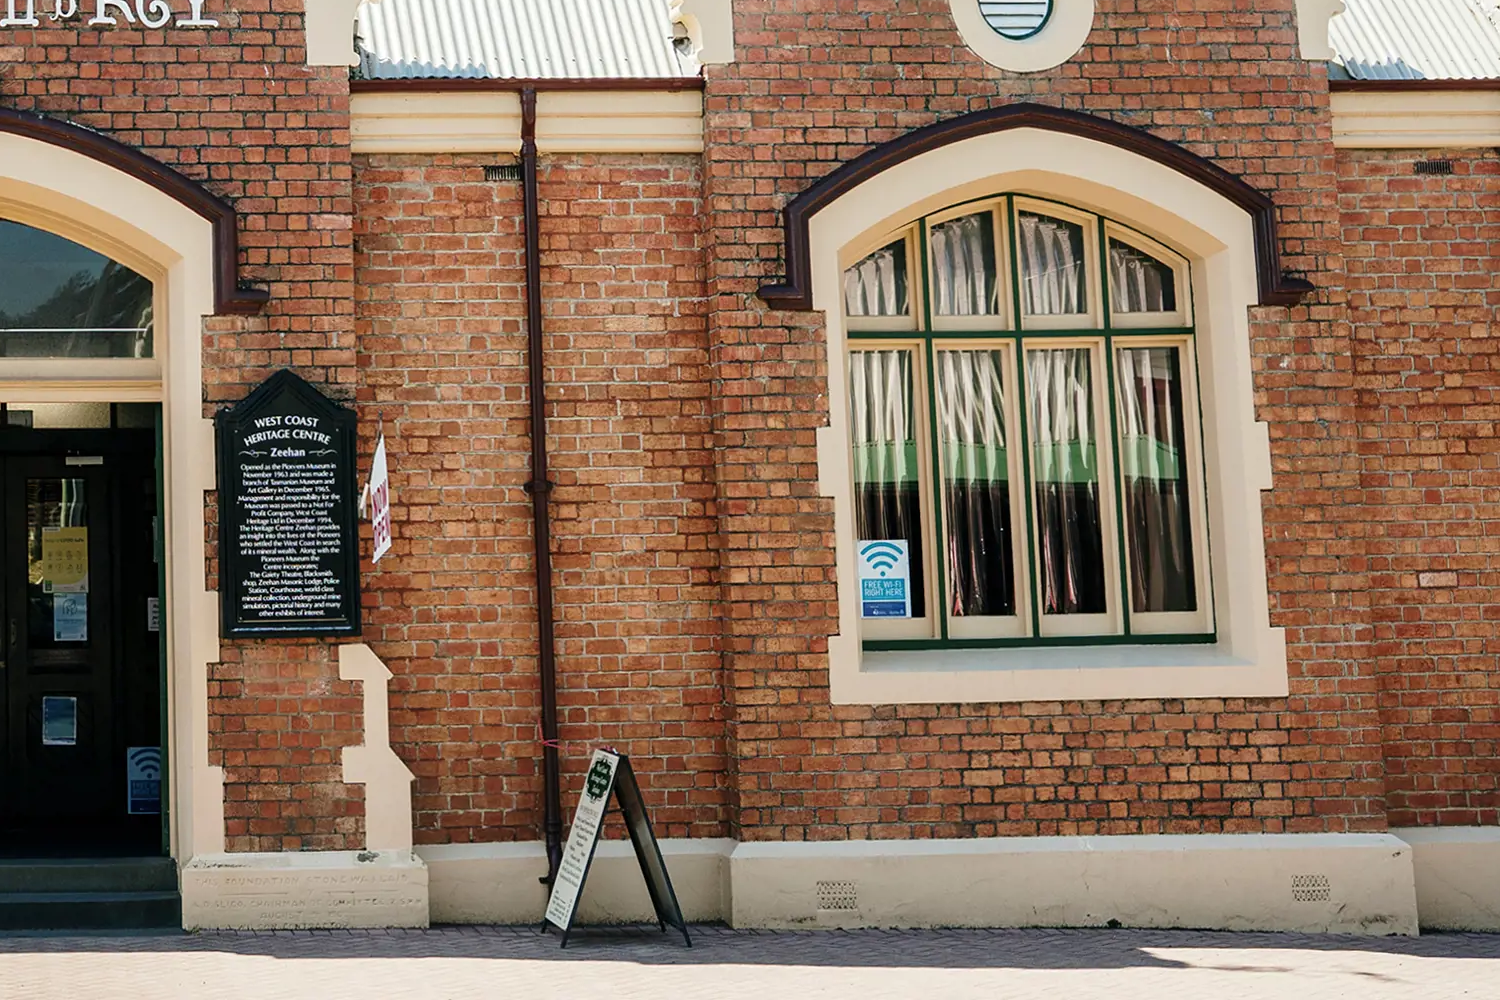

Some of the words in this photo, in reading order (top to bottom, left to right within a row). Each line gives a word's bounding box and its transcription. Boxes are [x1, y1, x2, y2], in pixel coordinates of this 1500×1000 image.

[254, 416, 282, 428] WEST
[284, 415, 320, 427] COAST
[243, 429, 291, 447] HERITAGE
[292, 429, 332, 445] CENTRE
[270, 447, 306, 457] Zeehan
[864, 580, 881, 589] FREE
[883, 580, 902, 589] WI-FI
[864, 588, 884, 597] RIGHT
[885, 588, 903, 597] HERE
[291, 594, 327, 602] underground
[294, 602, 313, 610] history
